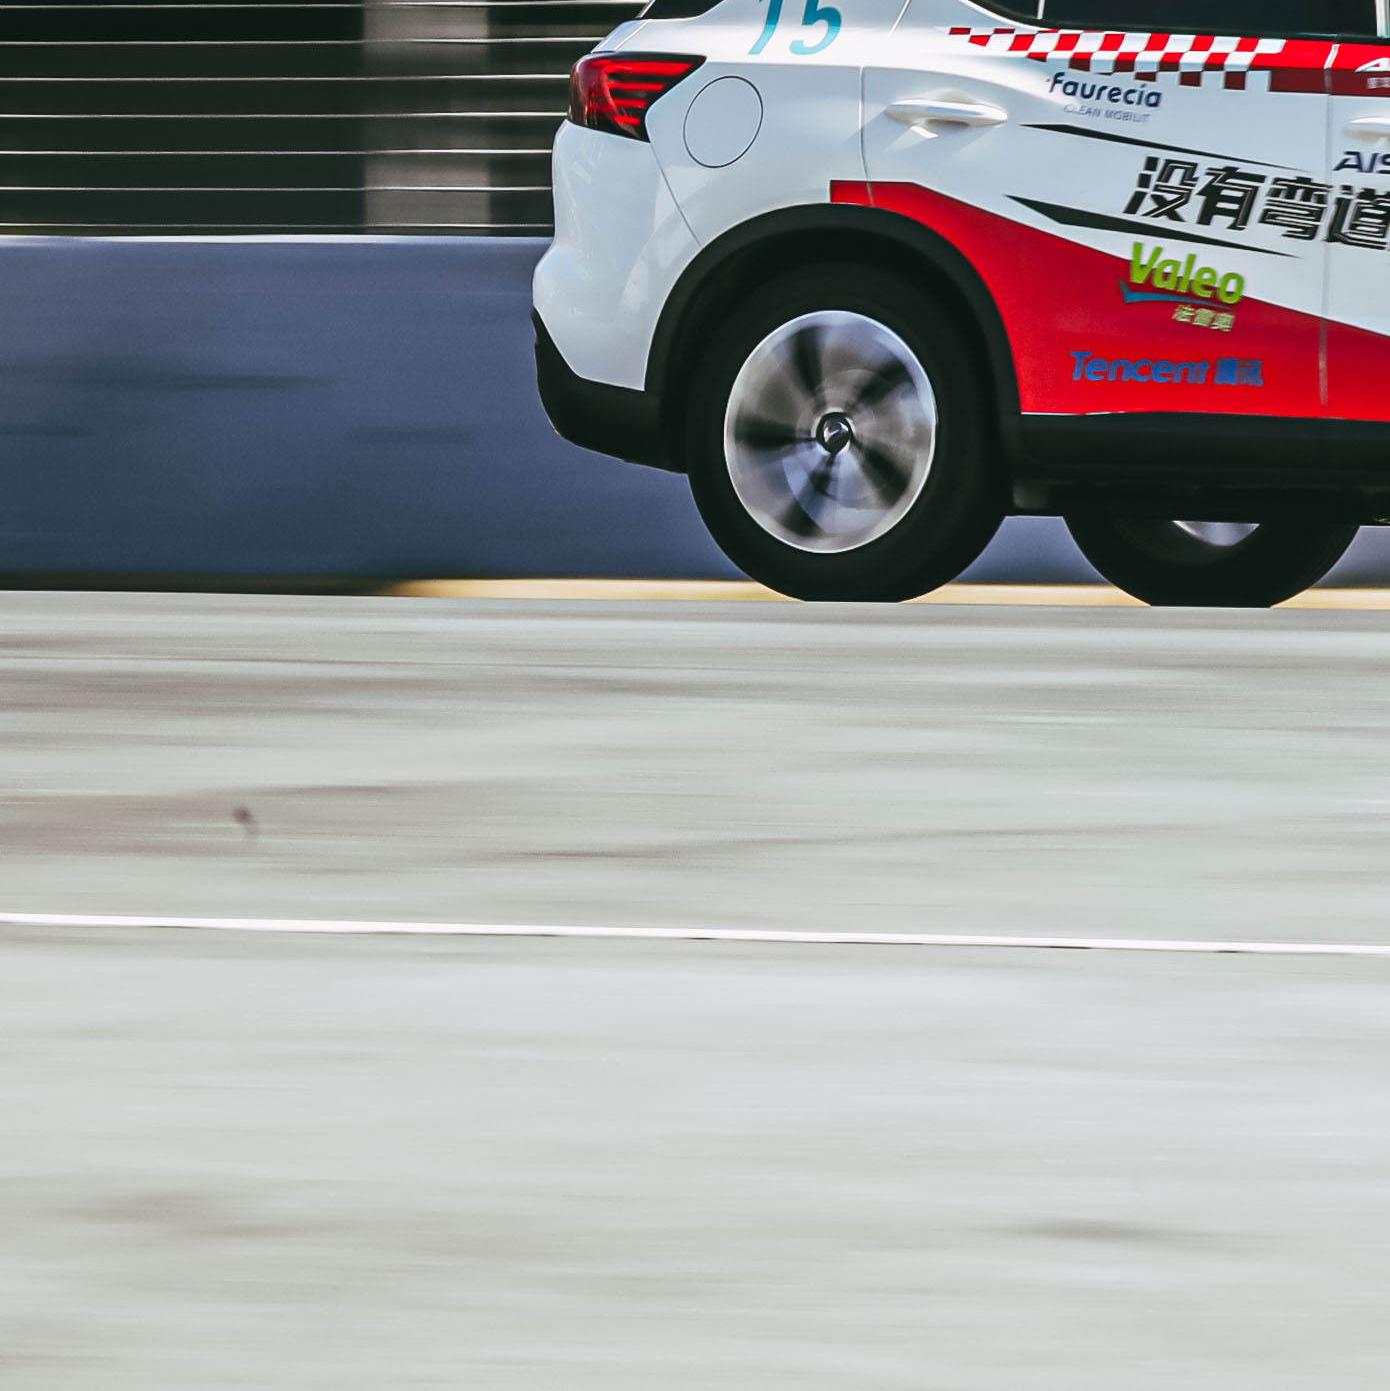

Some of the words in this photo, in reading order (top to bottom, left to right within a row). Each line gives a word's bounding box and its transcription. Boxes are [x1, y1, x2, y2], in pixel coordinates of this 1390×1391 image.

[1049, 71, 1163, 108] faurecia
[1129, 241, 1246, 304] Valeo
[1069, 351, 1210, 385] Tencent
